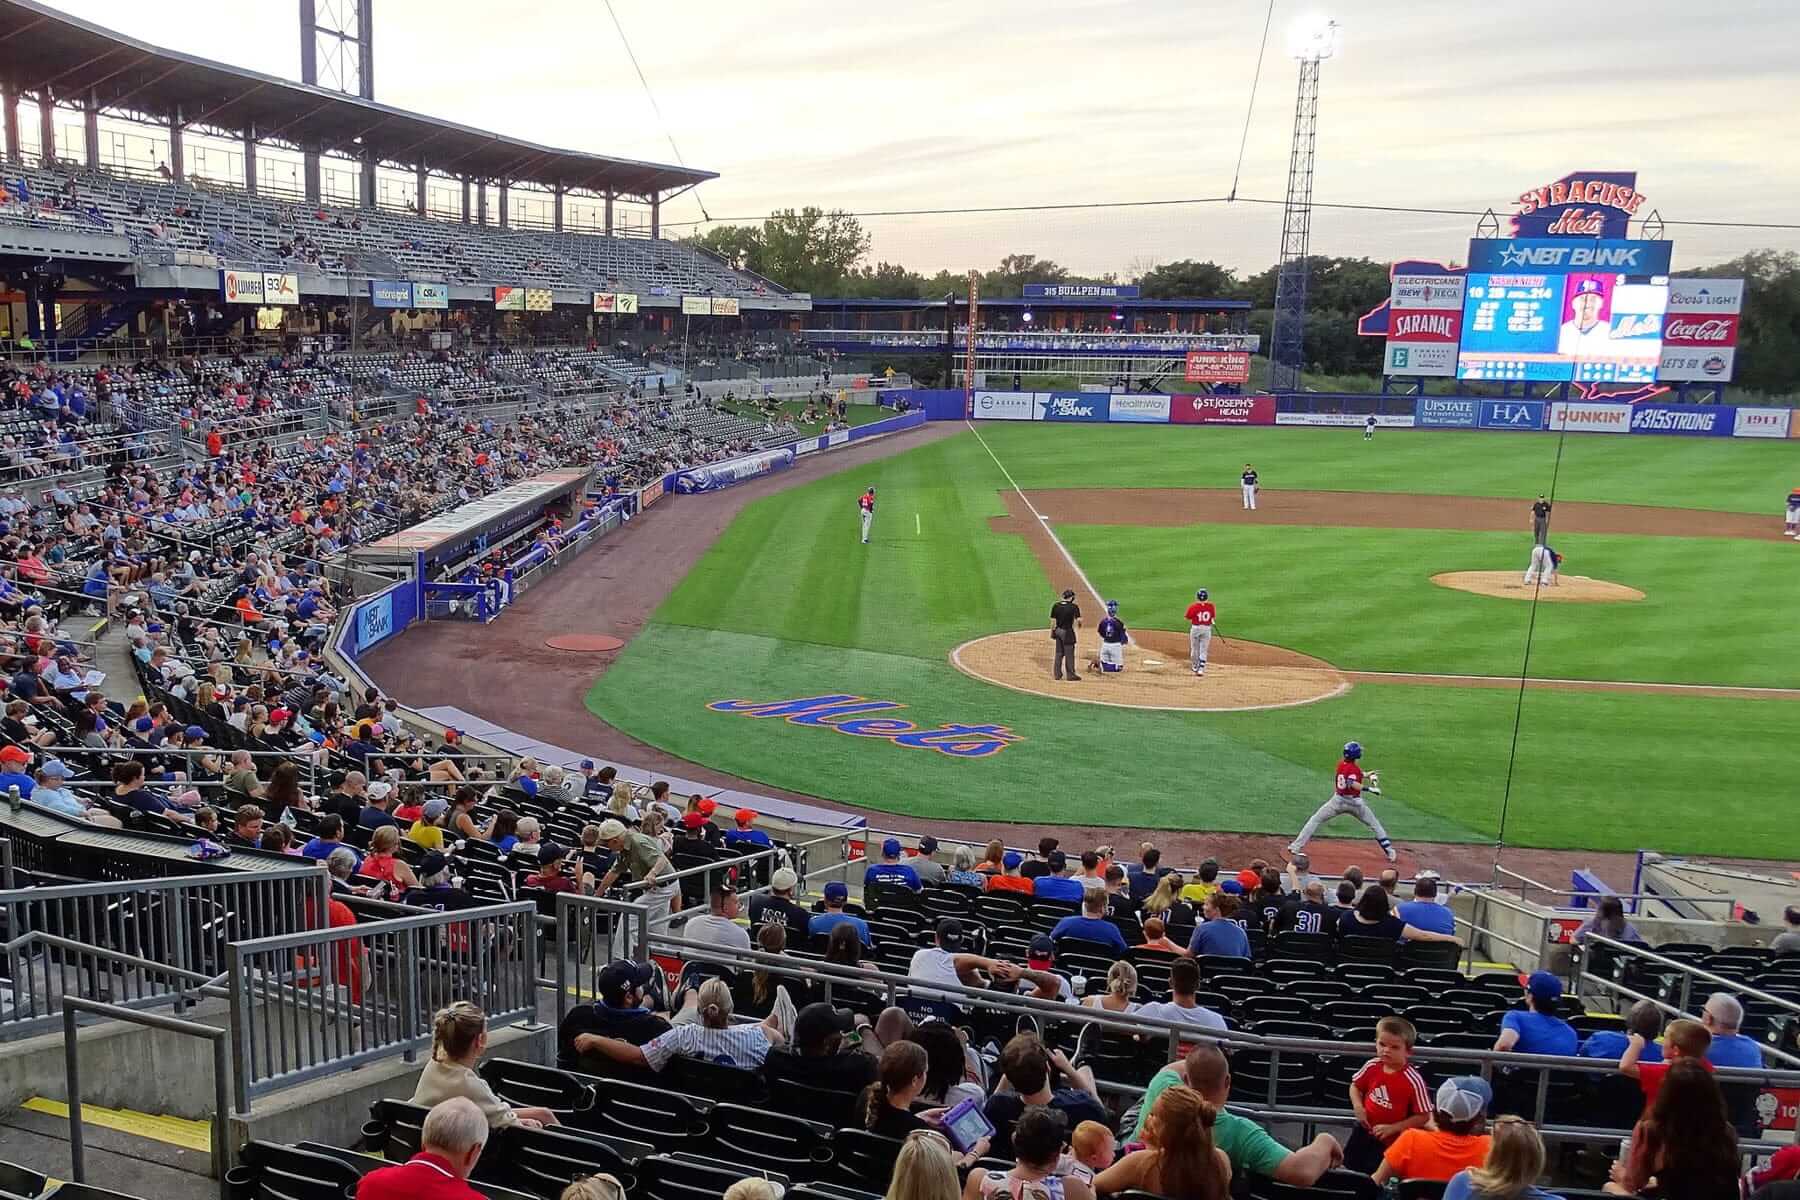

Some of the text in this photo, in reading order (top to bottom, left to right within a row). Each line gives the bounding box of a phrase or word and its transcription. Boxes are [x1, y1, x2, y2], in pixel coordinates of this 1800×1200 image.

[1519, 180, 1647, 215] SYRACUSE
[1547, 208, 1605, 235] Mets
[1520, 247, 1642, 267] NBT BANK
[238, 279, 263, 295] LUMBER
[1398, 277, 1461, 286] ELECTRICIANS
[1058, 286, 1101, 296] BULLPEN
[1706, 295, 1738, 305] LIGHT
[1394, 314, 1454, 337] SARANAC
[1190, 355, 1217, 363] JUNK
[1215, 398, 1255, 409] JOSEPH'S
[1219, 408, 1249, 416] HEALTH
[1557, 409, 1627, 425] DUNKIN'
[1632, 408, 1716, 431] #315STRONG
[1196, 612, 1210, 623] 10
[705, 694, 1027, 759] Mets
[1295, 910, 1321, 934] 31
[920, 1005, 933, 1014] NO
